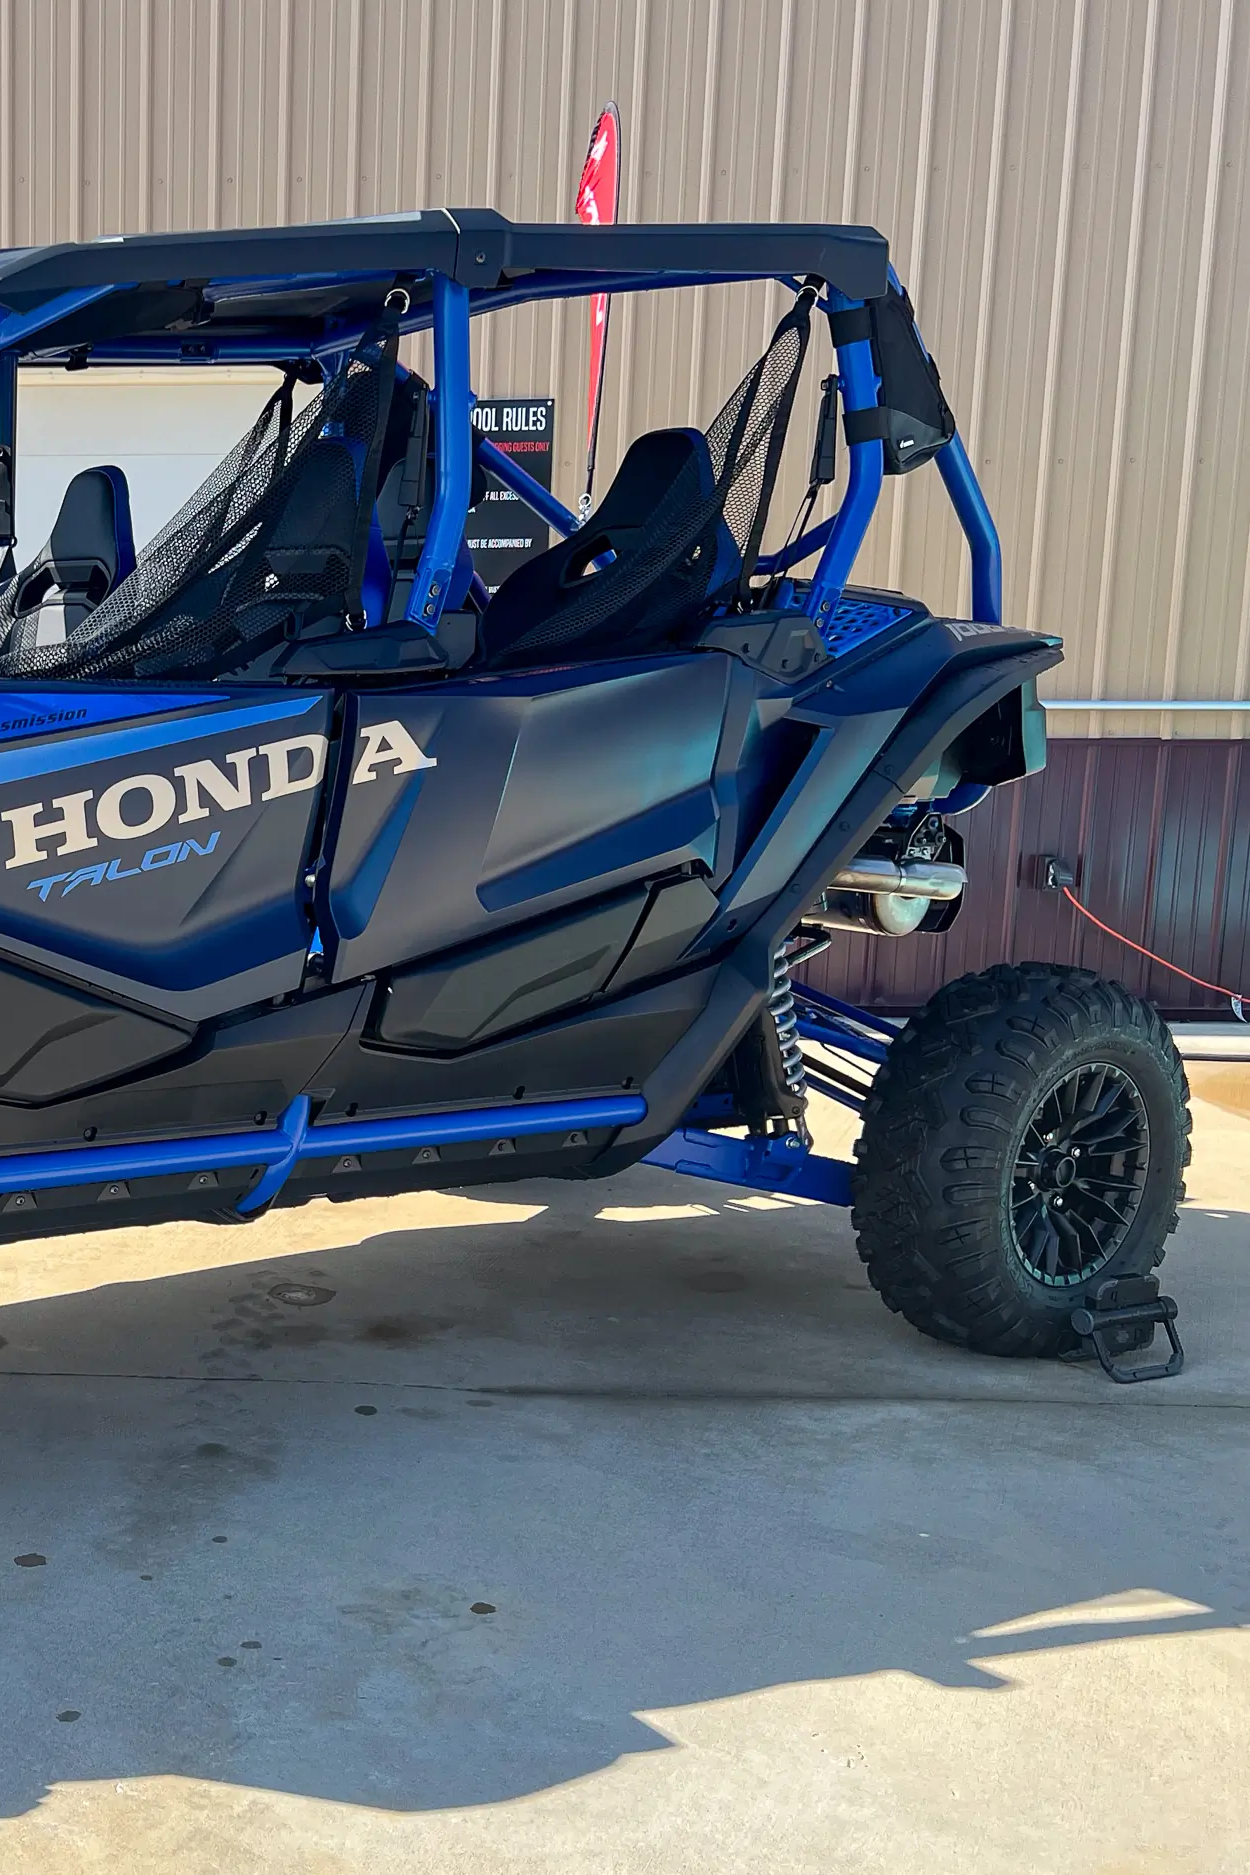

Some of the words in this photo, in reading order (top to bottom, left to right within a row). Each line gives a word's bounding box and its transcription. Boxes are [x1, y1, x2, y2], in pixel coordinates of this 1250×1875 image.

[502, 407, 546, 431] RULES
[513, 442, 535, 452] GUESTS
[536, 442, 549, 452] ONLY
[490, 491, 499, 500] ALL
[480, 539, 488, 548] BE
[488, 539, 524, 548] ACCOMPANIED
[525, 538, 533, 547] BY
[0, 720, 438, 870] HONDA
[26, 830, 222, 903] TALON
